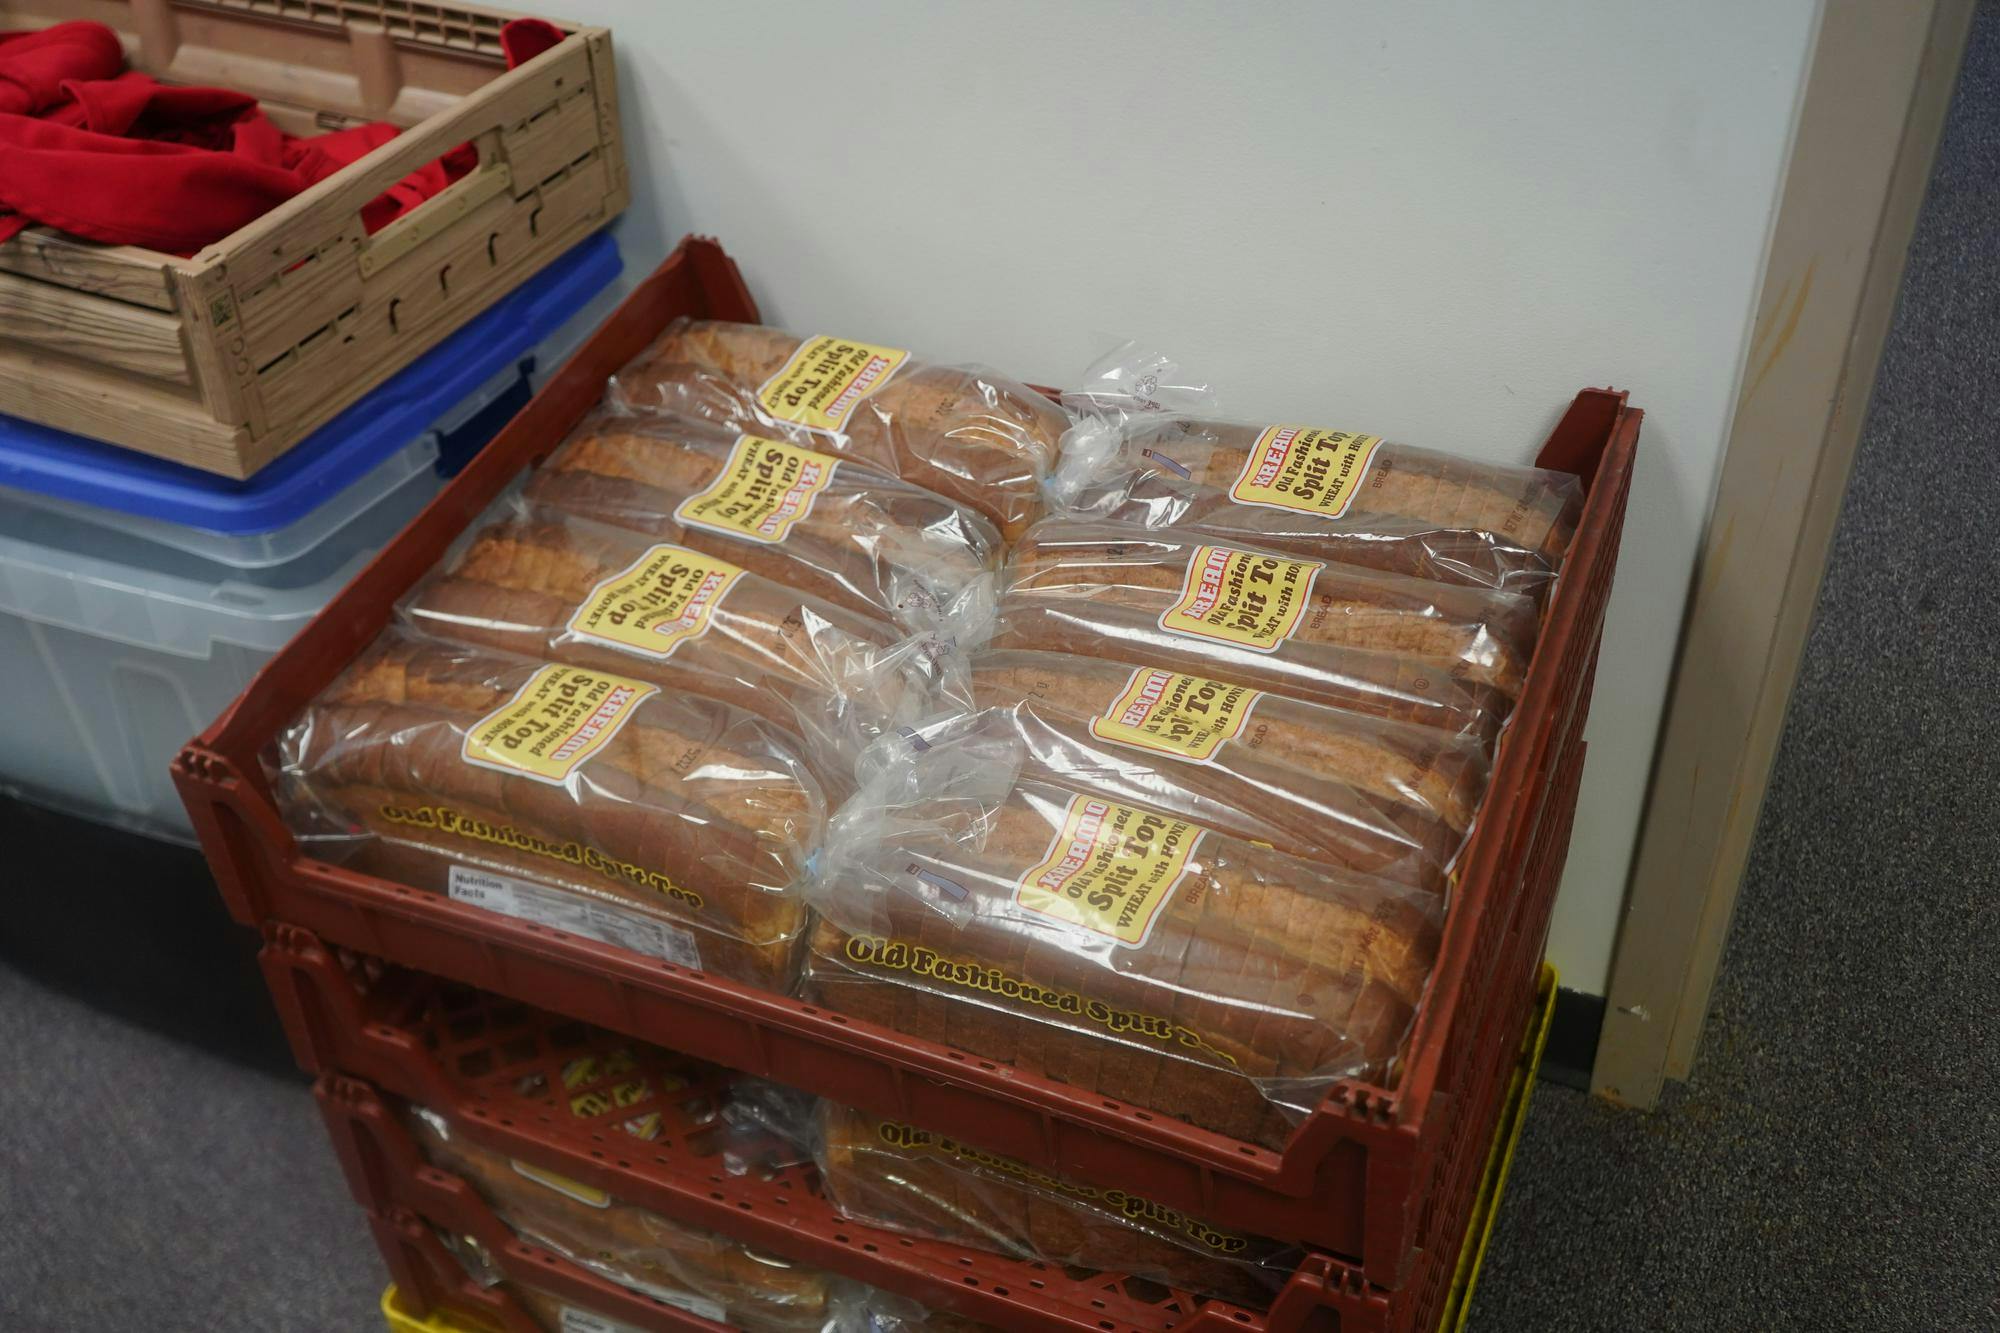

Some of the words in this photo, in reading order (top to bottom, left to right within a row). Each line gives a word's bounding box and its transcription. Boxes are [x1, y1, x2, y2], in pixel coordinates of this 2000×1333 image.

[813, 344, 854, 375] Split
[853, 349, 869, 366] Old
[784, 378, 823, 407] Top
[807, 364, 855, 410] Fashioned
[736, 439, 763, 481] WHEAT
[744, 448, 784, 501] Split
[782, 456, 799, 483] Old
[1372, 459, 1393, 489] BREAD
[1275, 476, 1296, 493] Old
[1293, 457, 1331, 501] Split
[1318, 477, 1345, 508] WHEAT
[1339, 453, 1357, 478] with
[634, 554, 671, 587] WHEAT
[683, 569, 704, 592] Old
[1181, 547, 1234, 621] KREAM
[1249, 558, 1279, 585] To
[1207, 610, 1229, 625] Old
[1252, 616, 1281, 640] WEAT
[1277, 587, 1294, 617] with
[1311, 594, 1332, 630] BREAD
[541, 674, 594, 719] Split
[585, 681, 611, 702] Old
[1185, 680, 1229, 715] Top
[500, 718, 550, 751] Top
[528, 700, 593, 758] Fashioned
[1210, 714, 1229, 733] ith
[379, 803, 437, 826] Old
[436, 806, 584, 866] Fashioned
[583, 846, 648, 885] Split
[649, 872, 705, 911] Top
[1066, 879, 1088, 899] Old
[1082, 807, 1134, 882] Fashioned
[1087, 865, 1138, 913] Split
[1122, 815, 1167, 860] Top
[454, 885, 486, 899] Facts
[455, 872, 504, 891] Nutrition
[1116, 883, 1153, 929] WHEAT
[1148, 859, 1170, 883] with
[845, 933, 906, 969] Old
[911, 945, 1083, 1015] Fashioned
[1086, 998, 1174, 1038] Split
